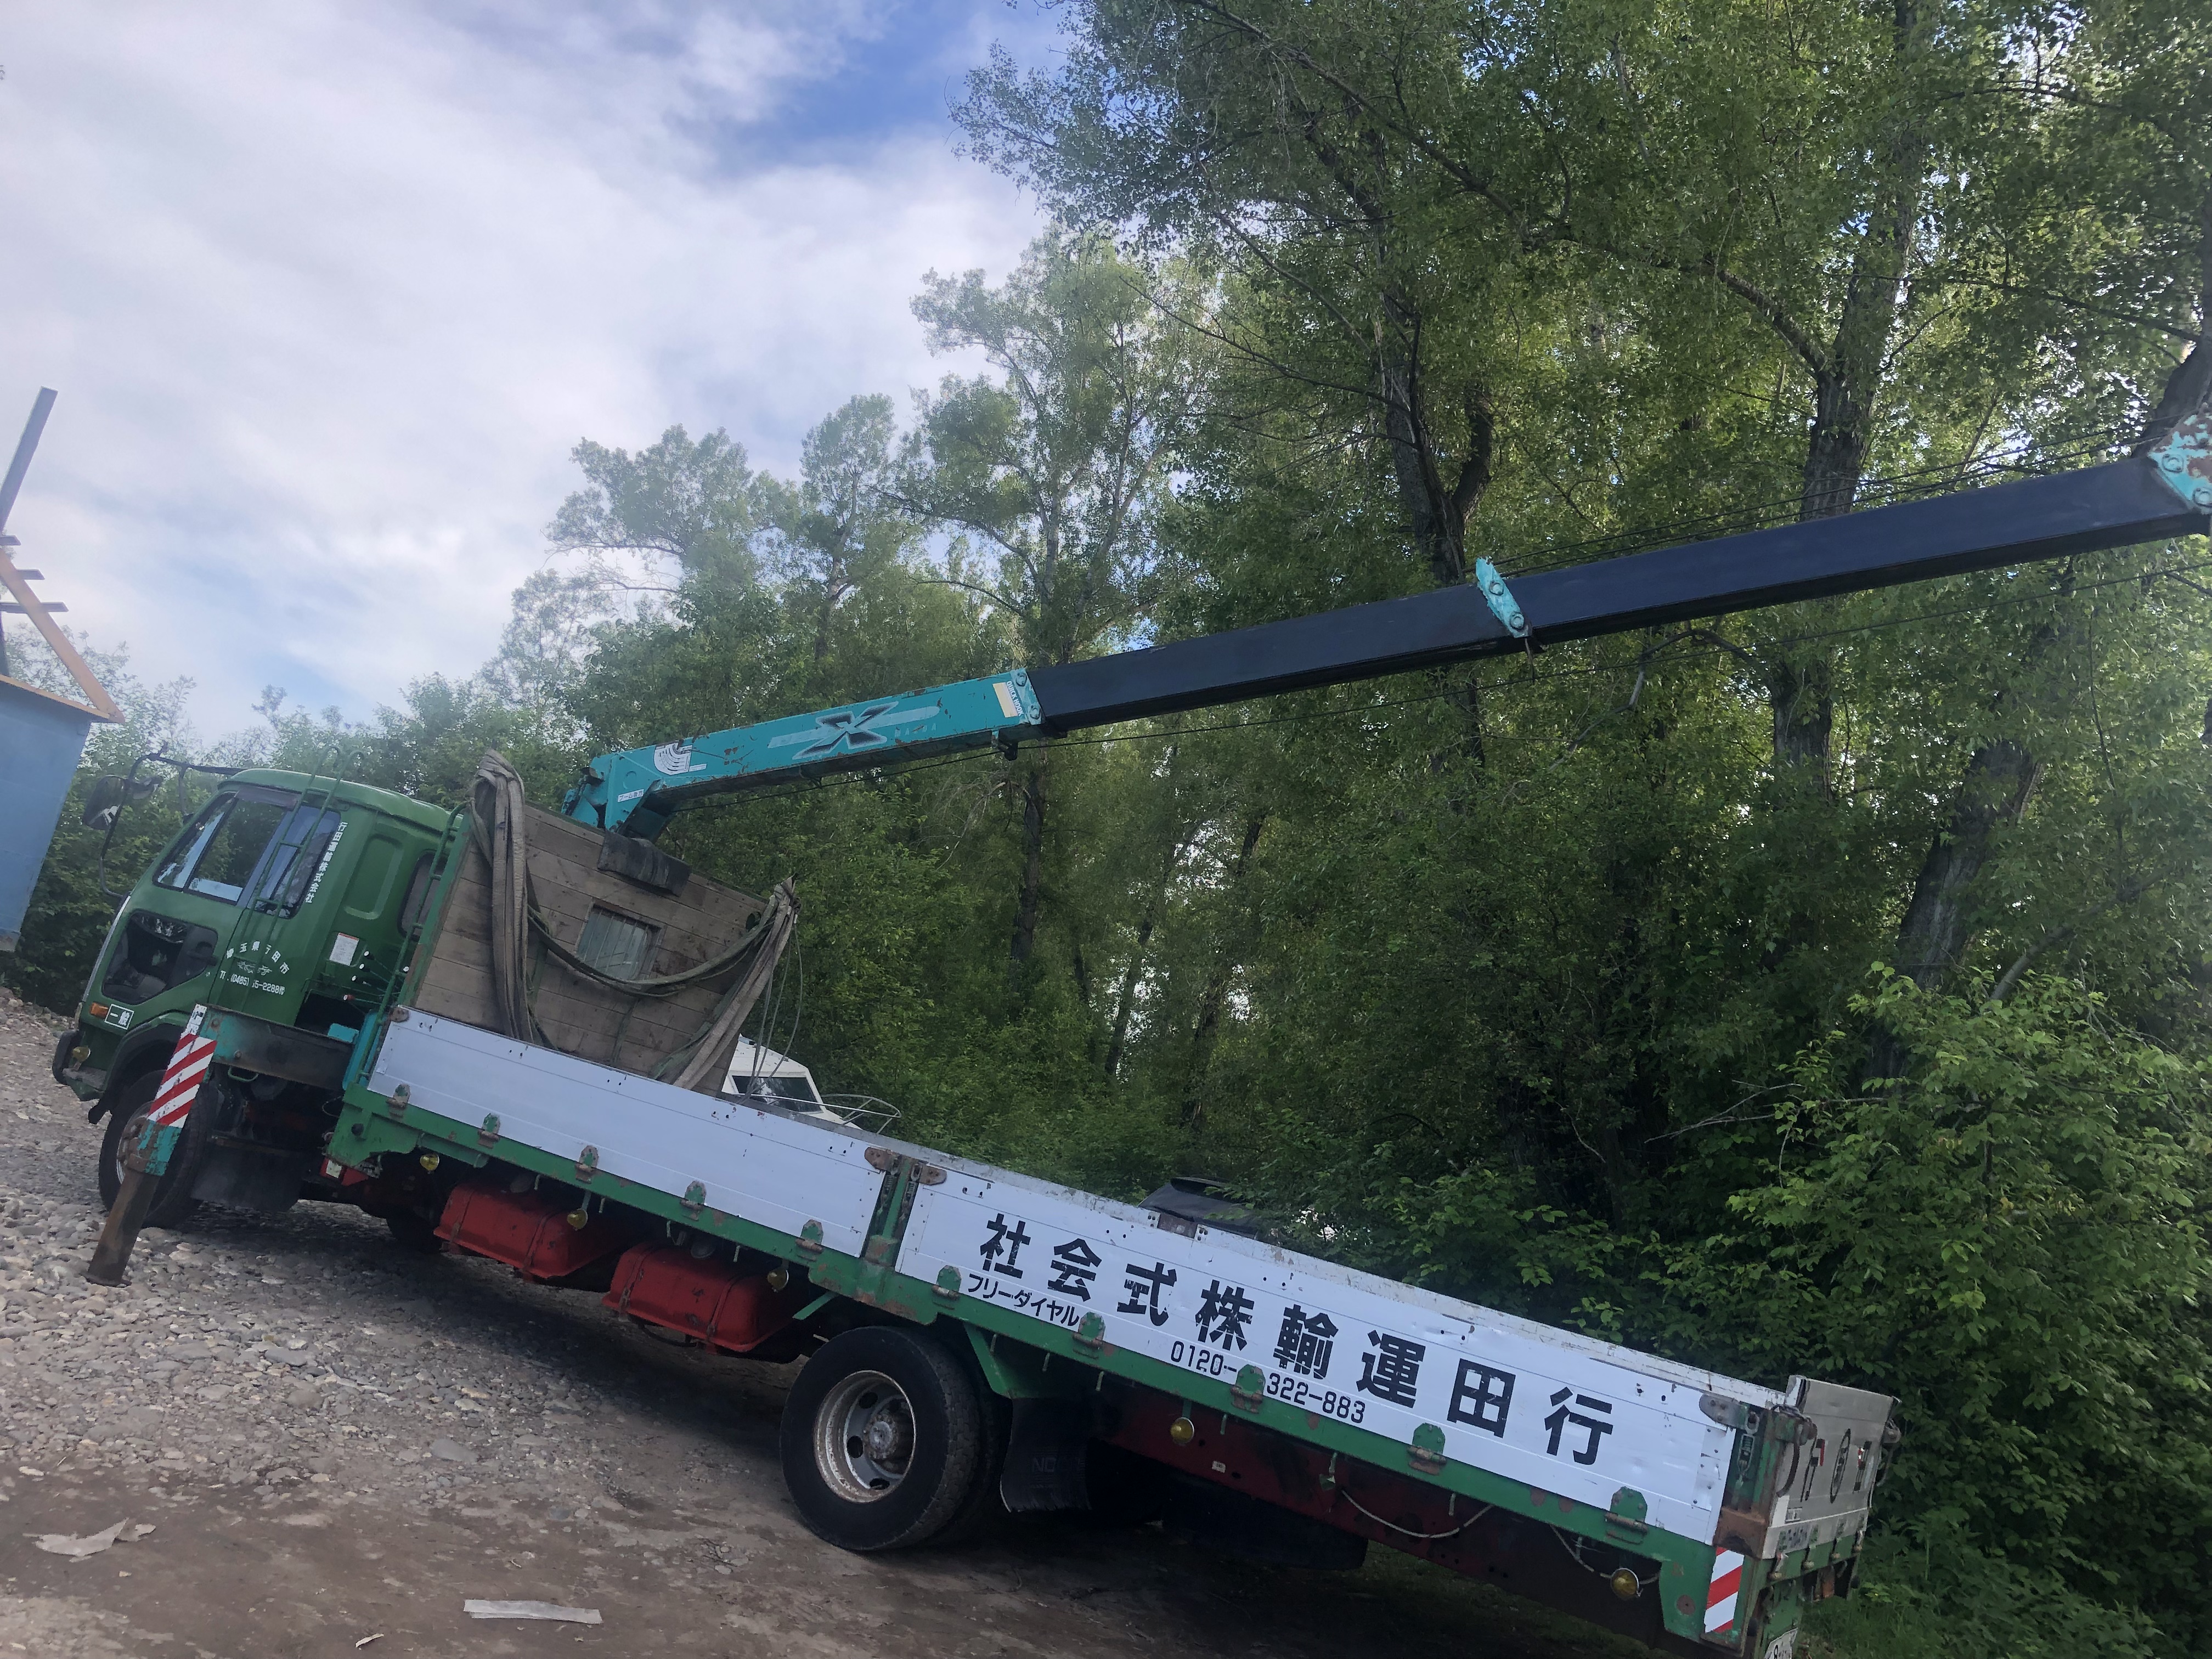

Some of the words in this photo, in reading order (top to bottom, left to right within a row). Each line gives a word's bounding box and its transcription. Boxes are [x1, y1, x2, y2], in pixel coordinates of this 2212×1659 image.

[1006, 680, 1018, 699] QUICK
[1013, 698, 1024, 716] HOOK
[968, 1273, 1080, 1327] フリーダイヤル
[1267, 1373, 1366, 1424] 322-883
